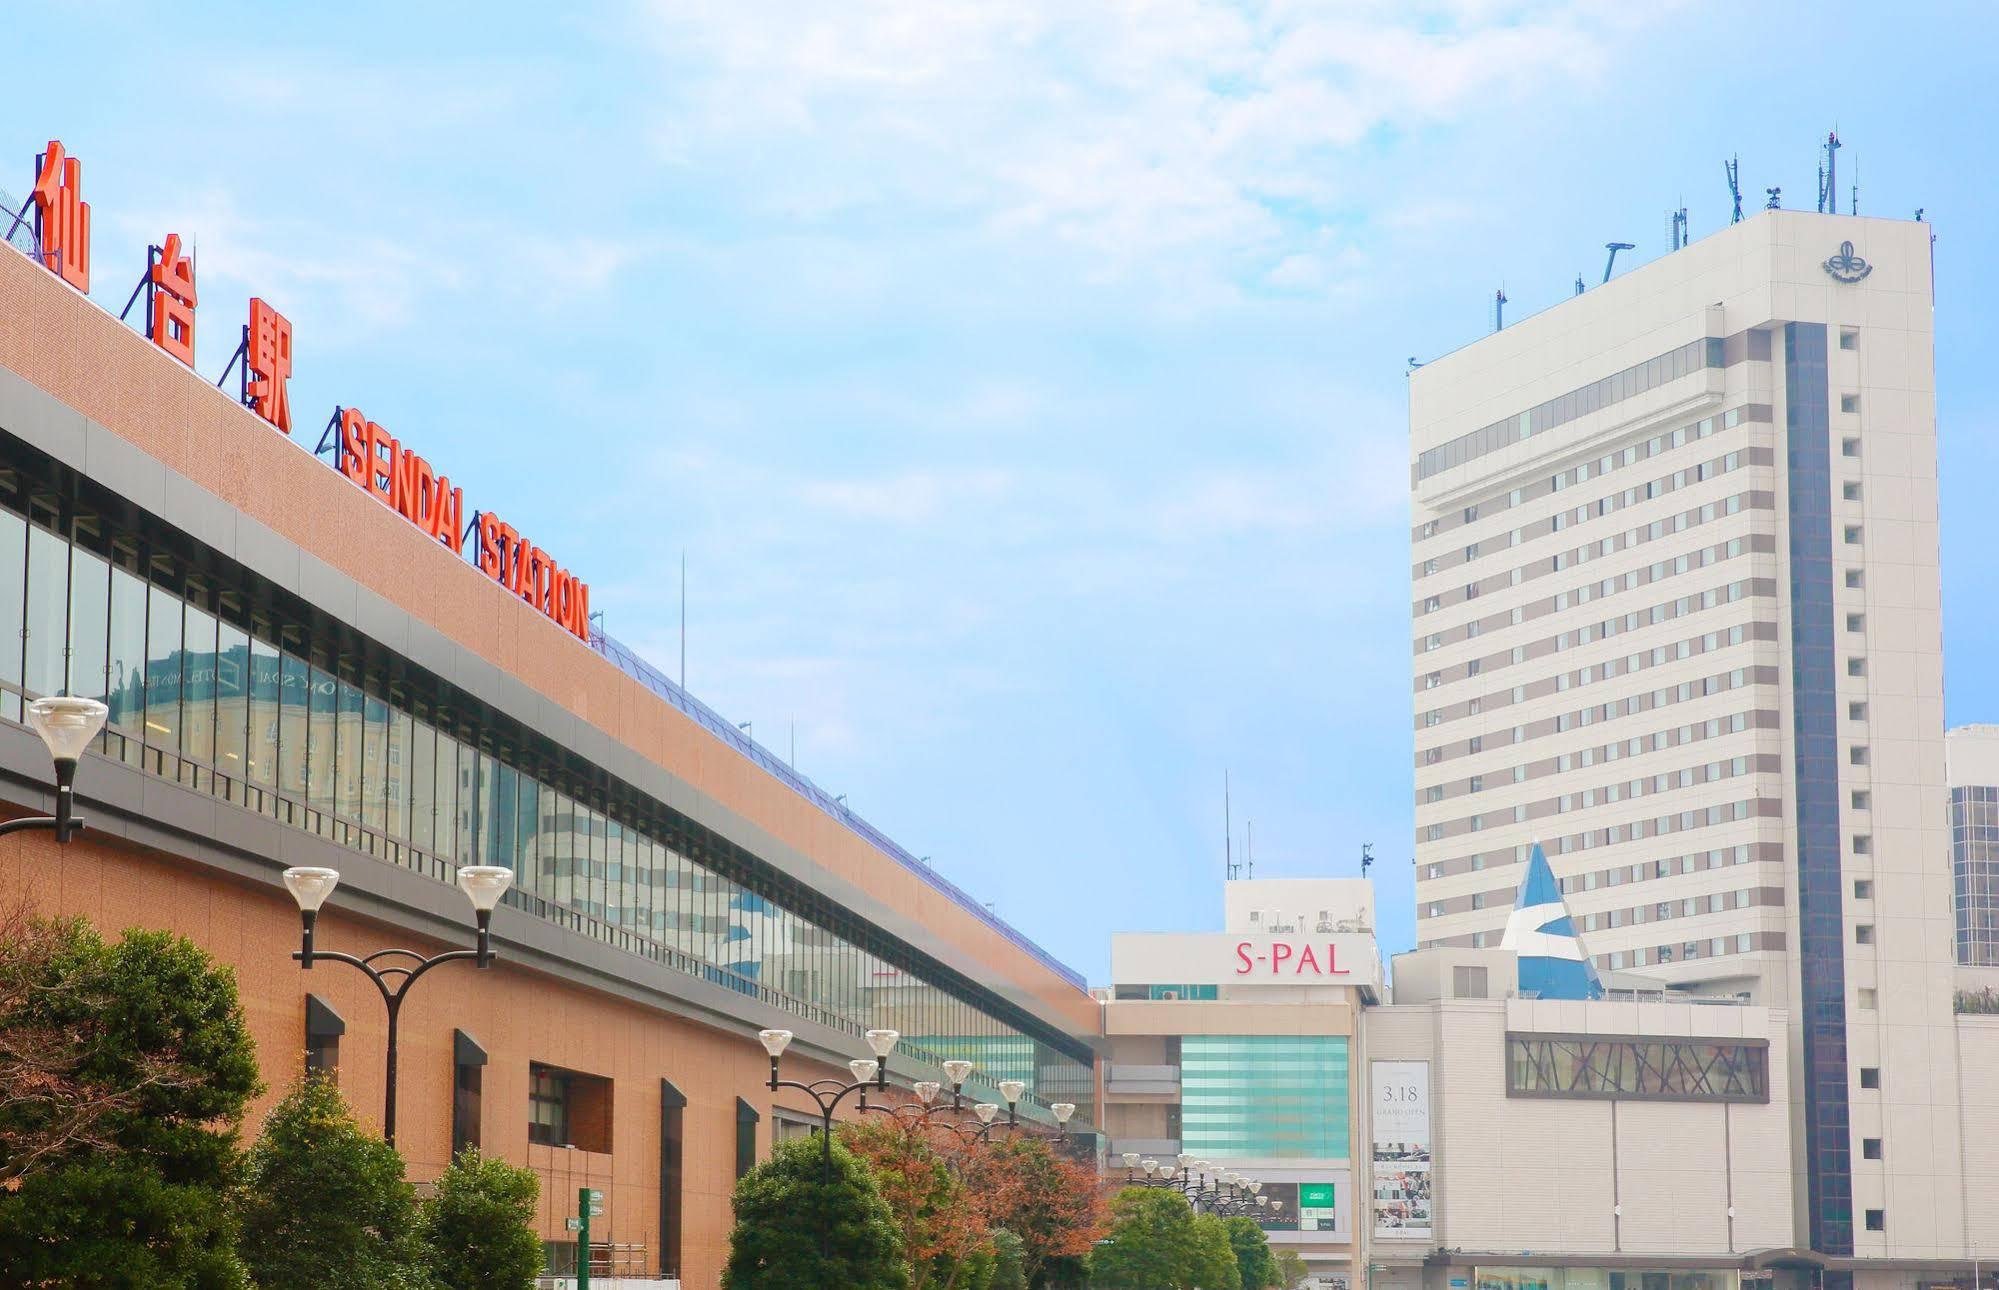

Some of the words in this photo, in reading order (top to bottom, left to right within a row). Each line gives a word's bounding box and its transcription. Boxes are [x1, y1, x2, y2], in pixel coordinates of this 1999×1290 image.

[34, 140, 292, 435] 仙台駅
[342, 408, 463, 555] SENDAI
[480, 512, 589, 643] STATION
[1237, 942, 1350, 974] S-PAL
[1383, 1085, 1418, 1102] 3.18
